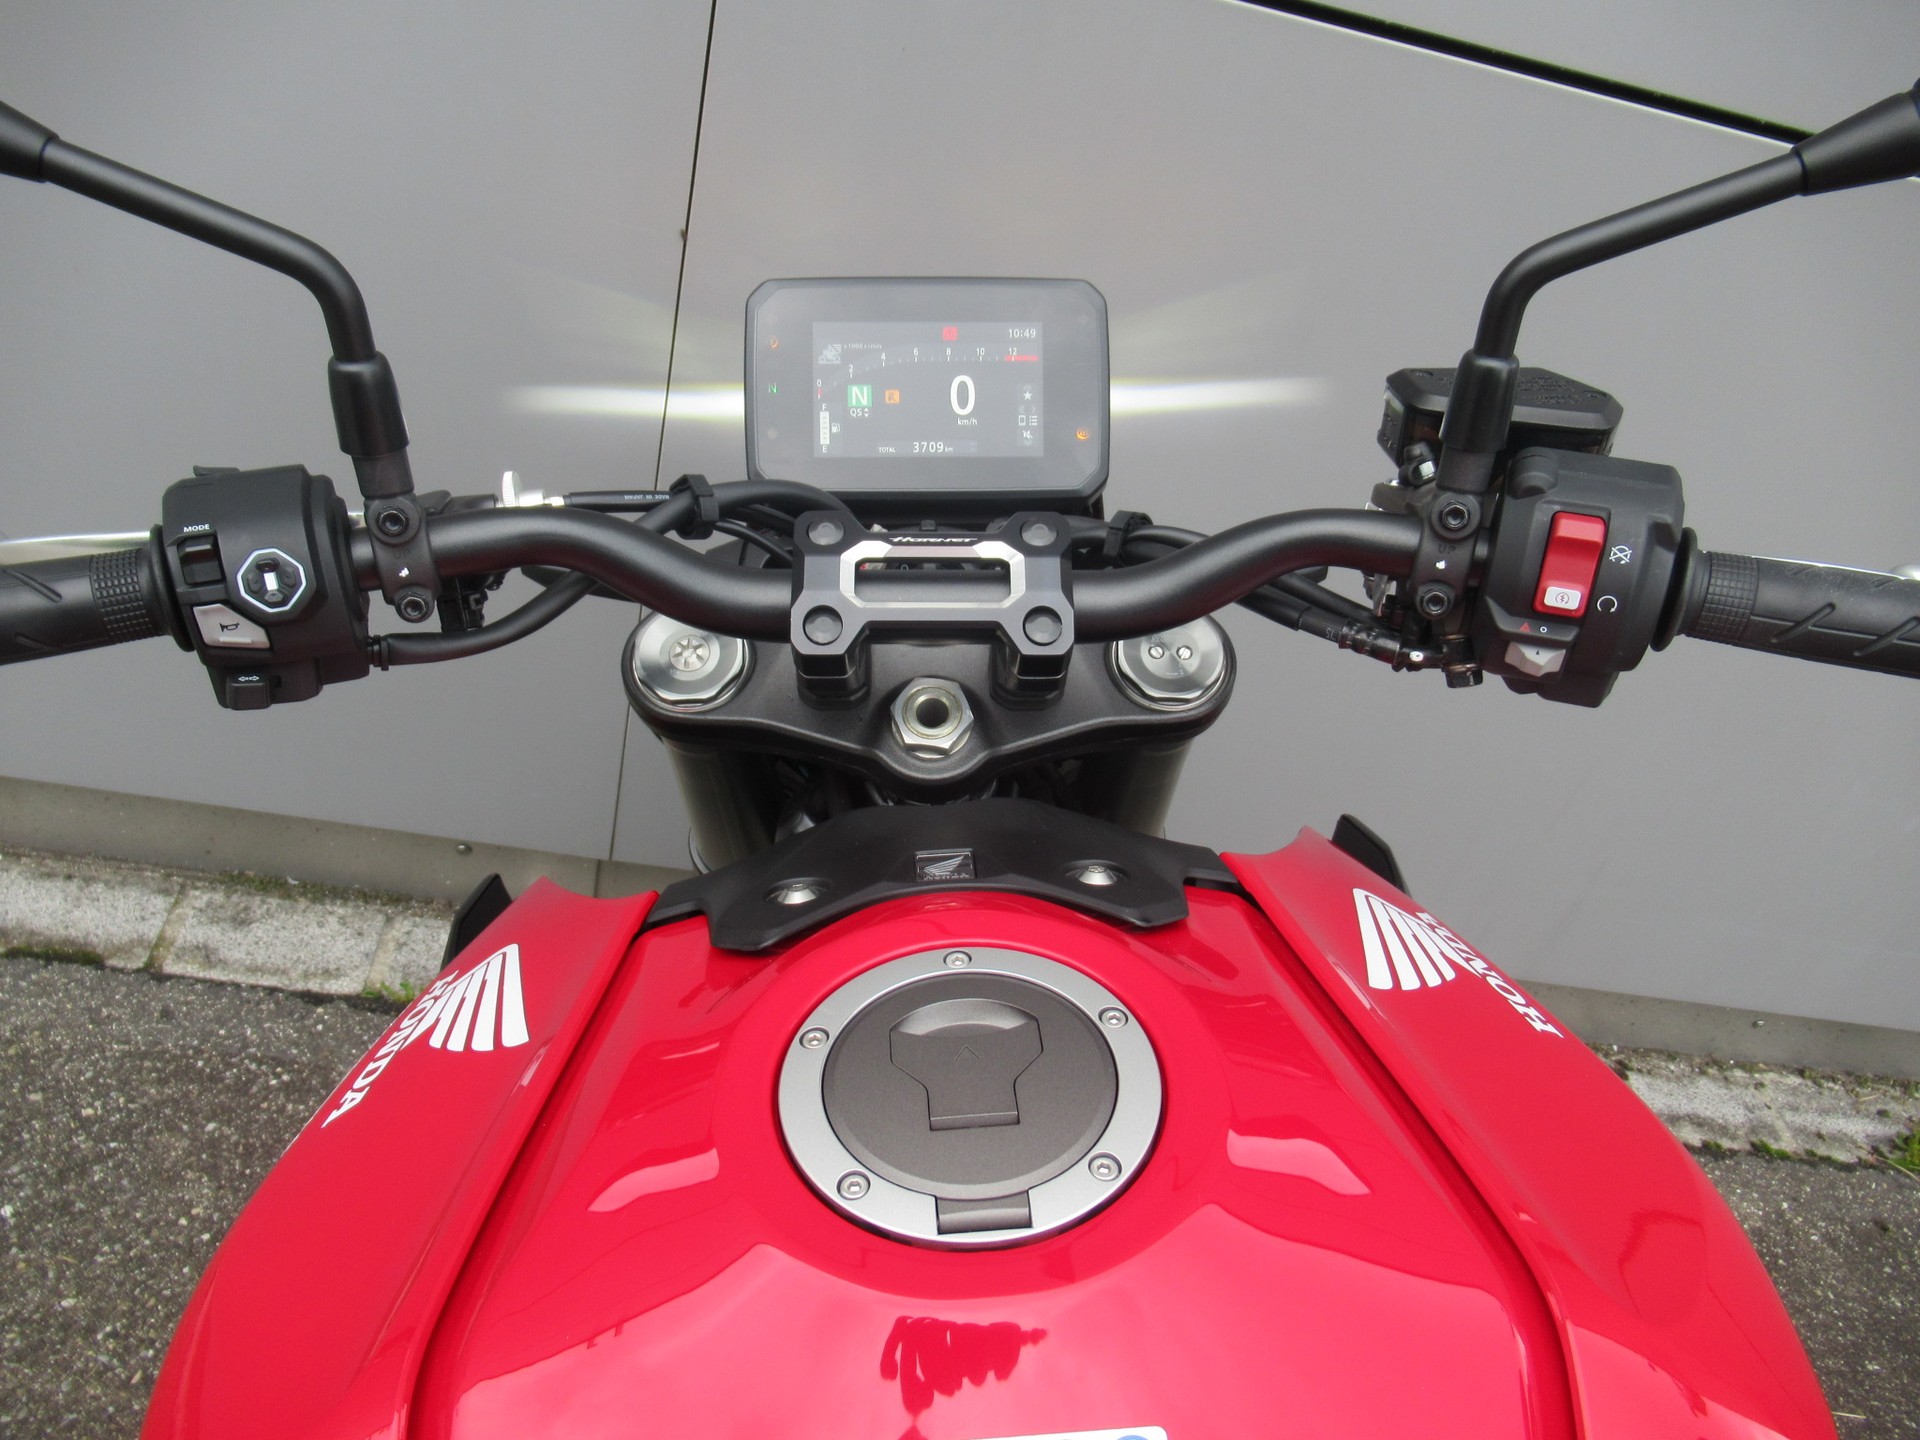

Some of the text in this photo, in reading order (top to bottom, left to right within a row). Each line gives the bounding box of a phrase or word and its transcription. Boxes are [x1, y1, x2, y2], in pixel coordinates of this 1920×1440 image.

[1008, 328, 1036, 338] 10:49
[913, 347, 919, 356] 6
[946, 347, 952, 356] 8
[976, 347, 986, 356] 10
[1008, 347, 1018, 356] 12
[880, 352, 886, 361] 4
[851, 385, 869, 406] N
[950, 374, 976, 416] 0
[821, 403, 828, 411] F
[849, 408, 863, 417] QS
[957, 417, 978, 426] km/h
[822, 445, 828, 453] E
[912, 441, 944, 453] 3709
[183, 523, 210, 533] MODE
[1415, 911, 1564, 1038] HONDA
[321, 969, 459, 1129] HONDA
